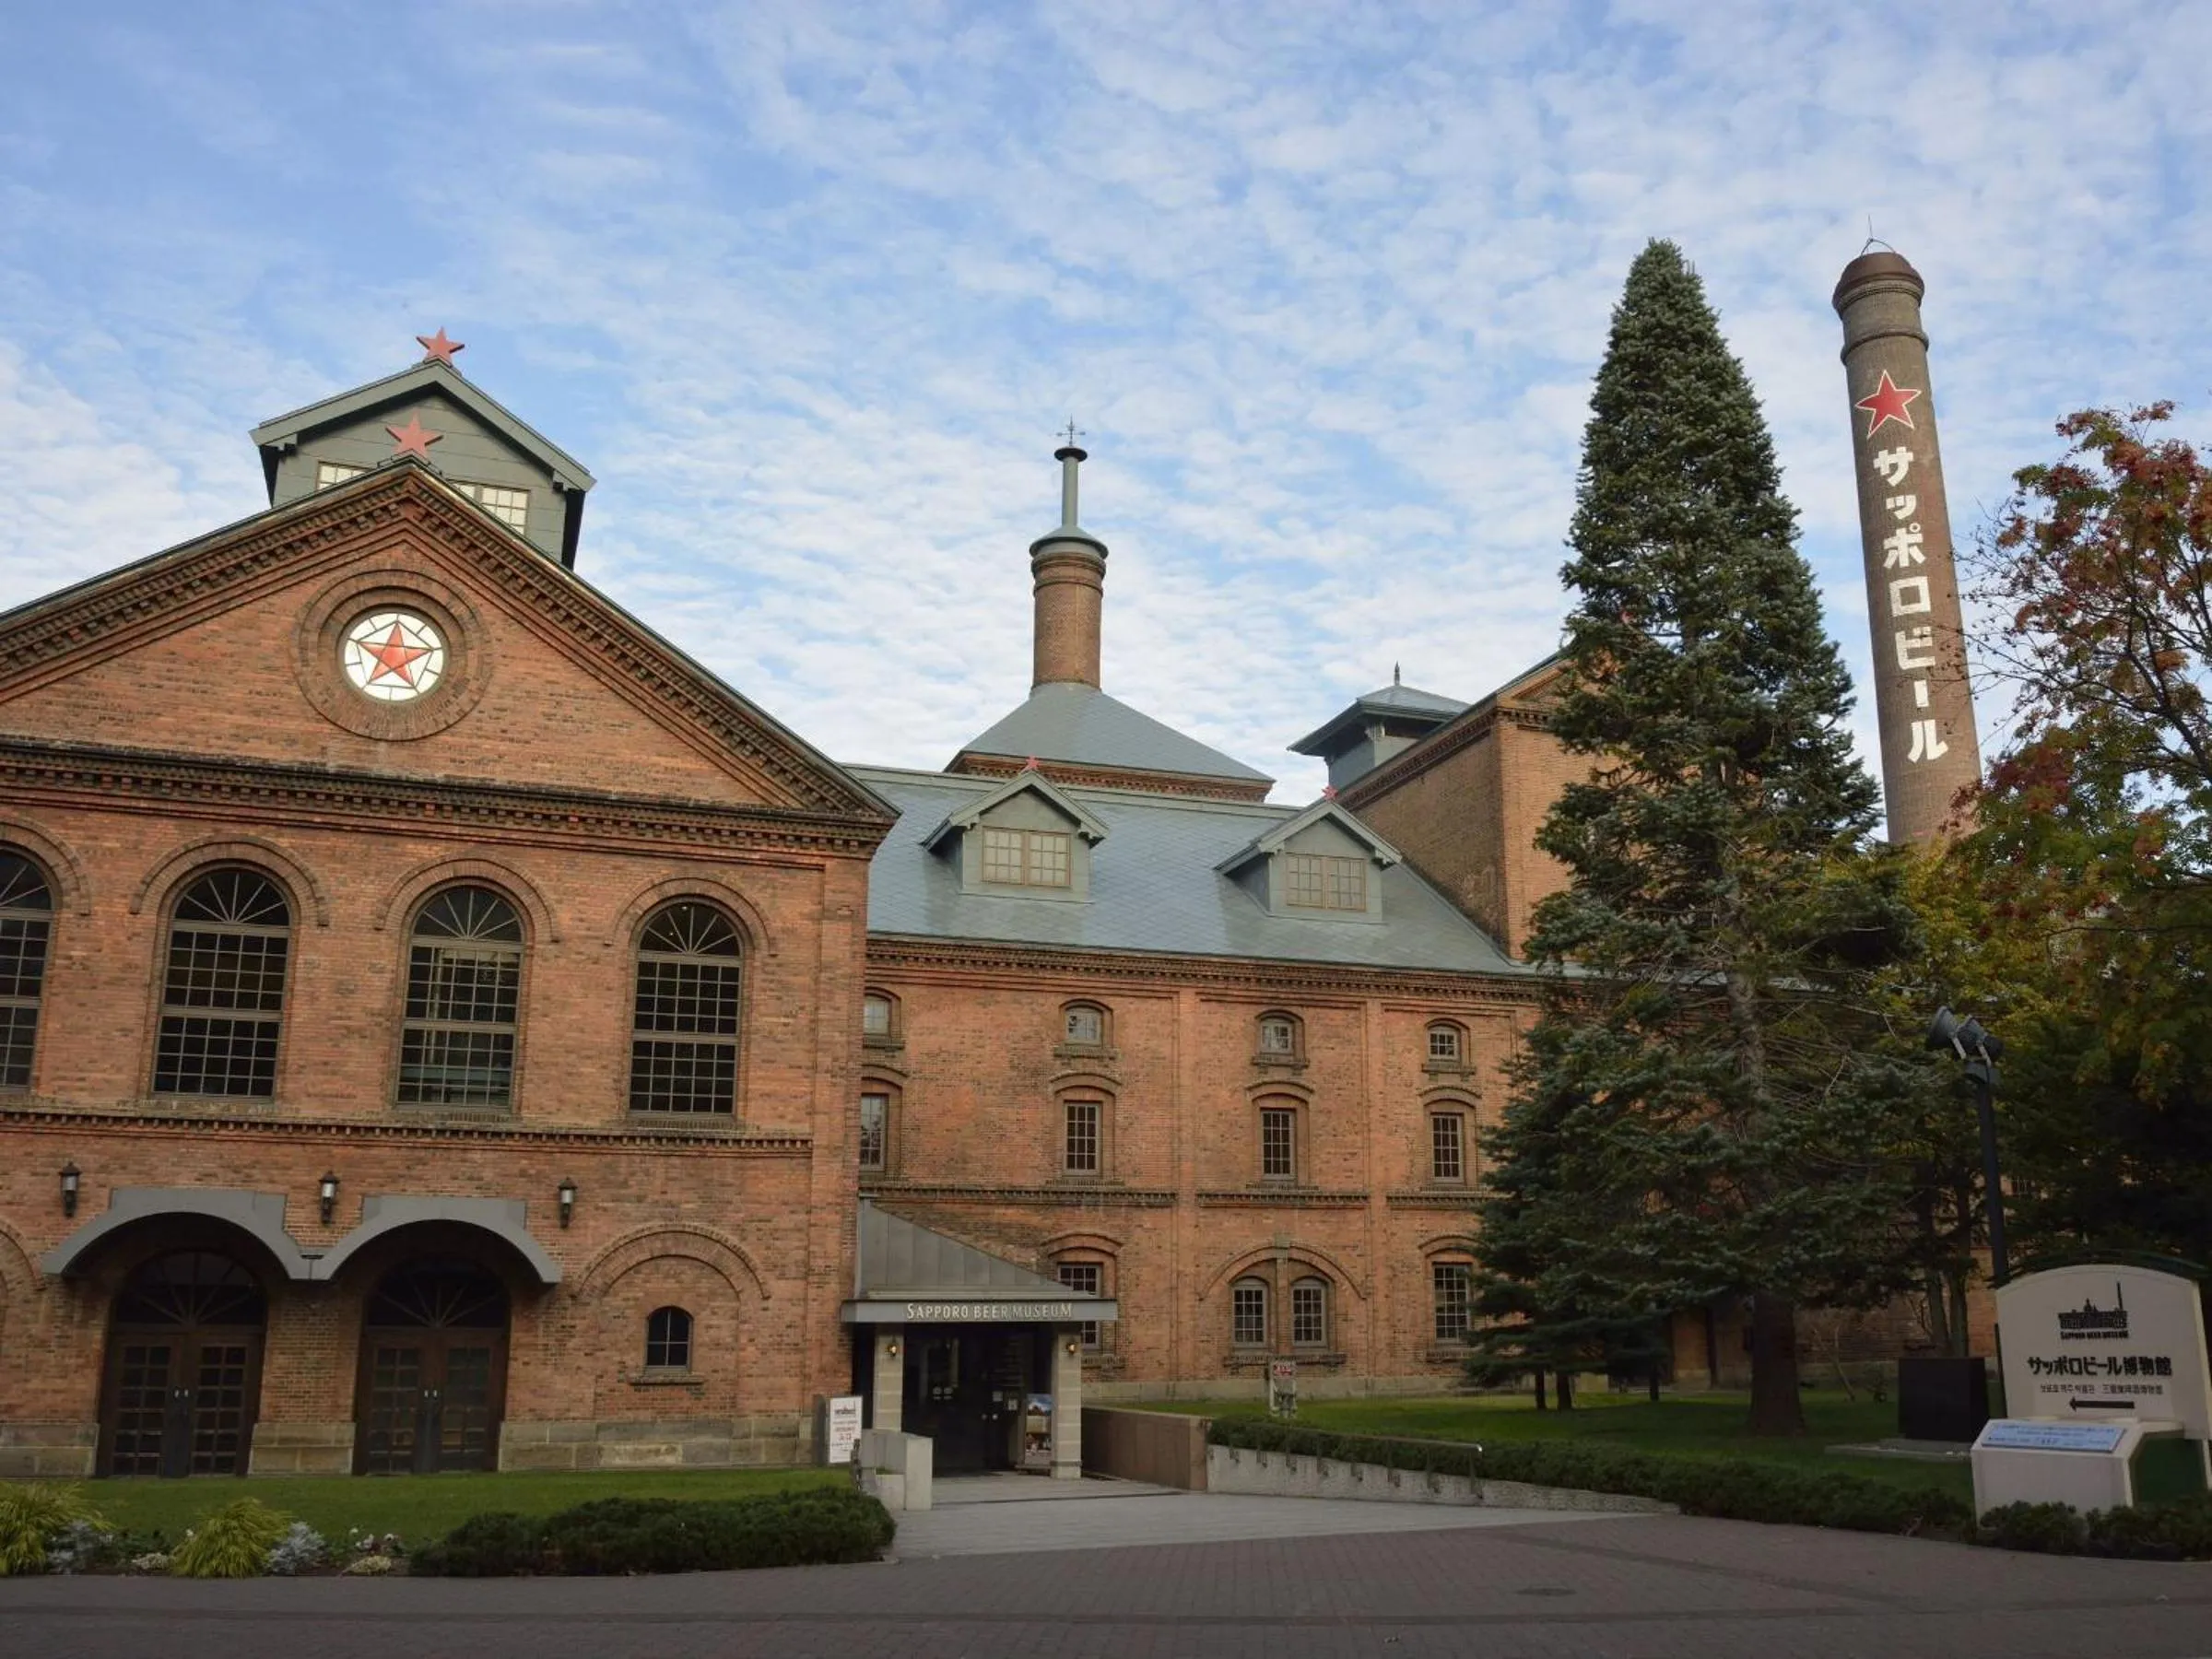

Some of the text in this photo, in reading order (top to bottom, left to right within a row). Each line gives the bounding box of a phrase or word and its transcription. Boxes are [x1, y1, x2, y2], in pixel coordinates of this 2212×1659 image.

[1873, 446, 1948, 763] サッポロビール
[907, 1303, 1072, 1319] SAPPORO BEER MUSEUM
[2028, 1355, 2172, 1376] サッポロビール博物館
